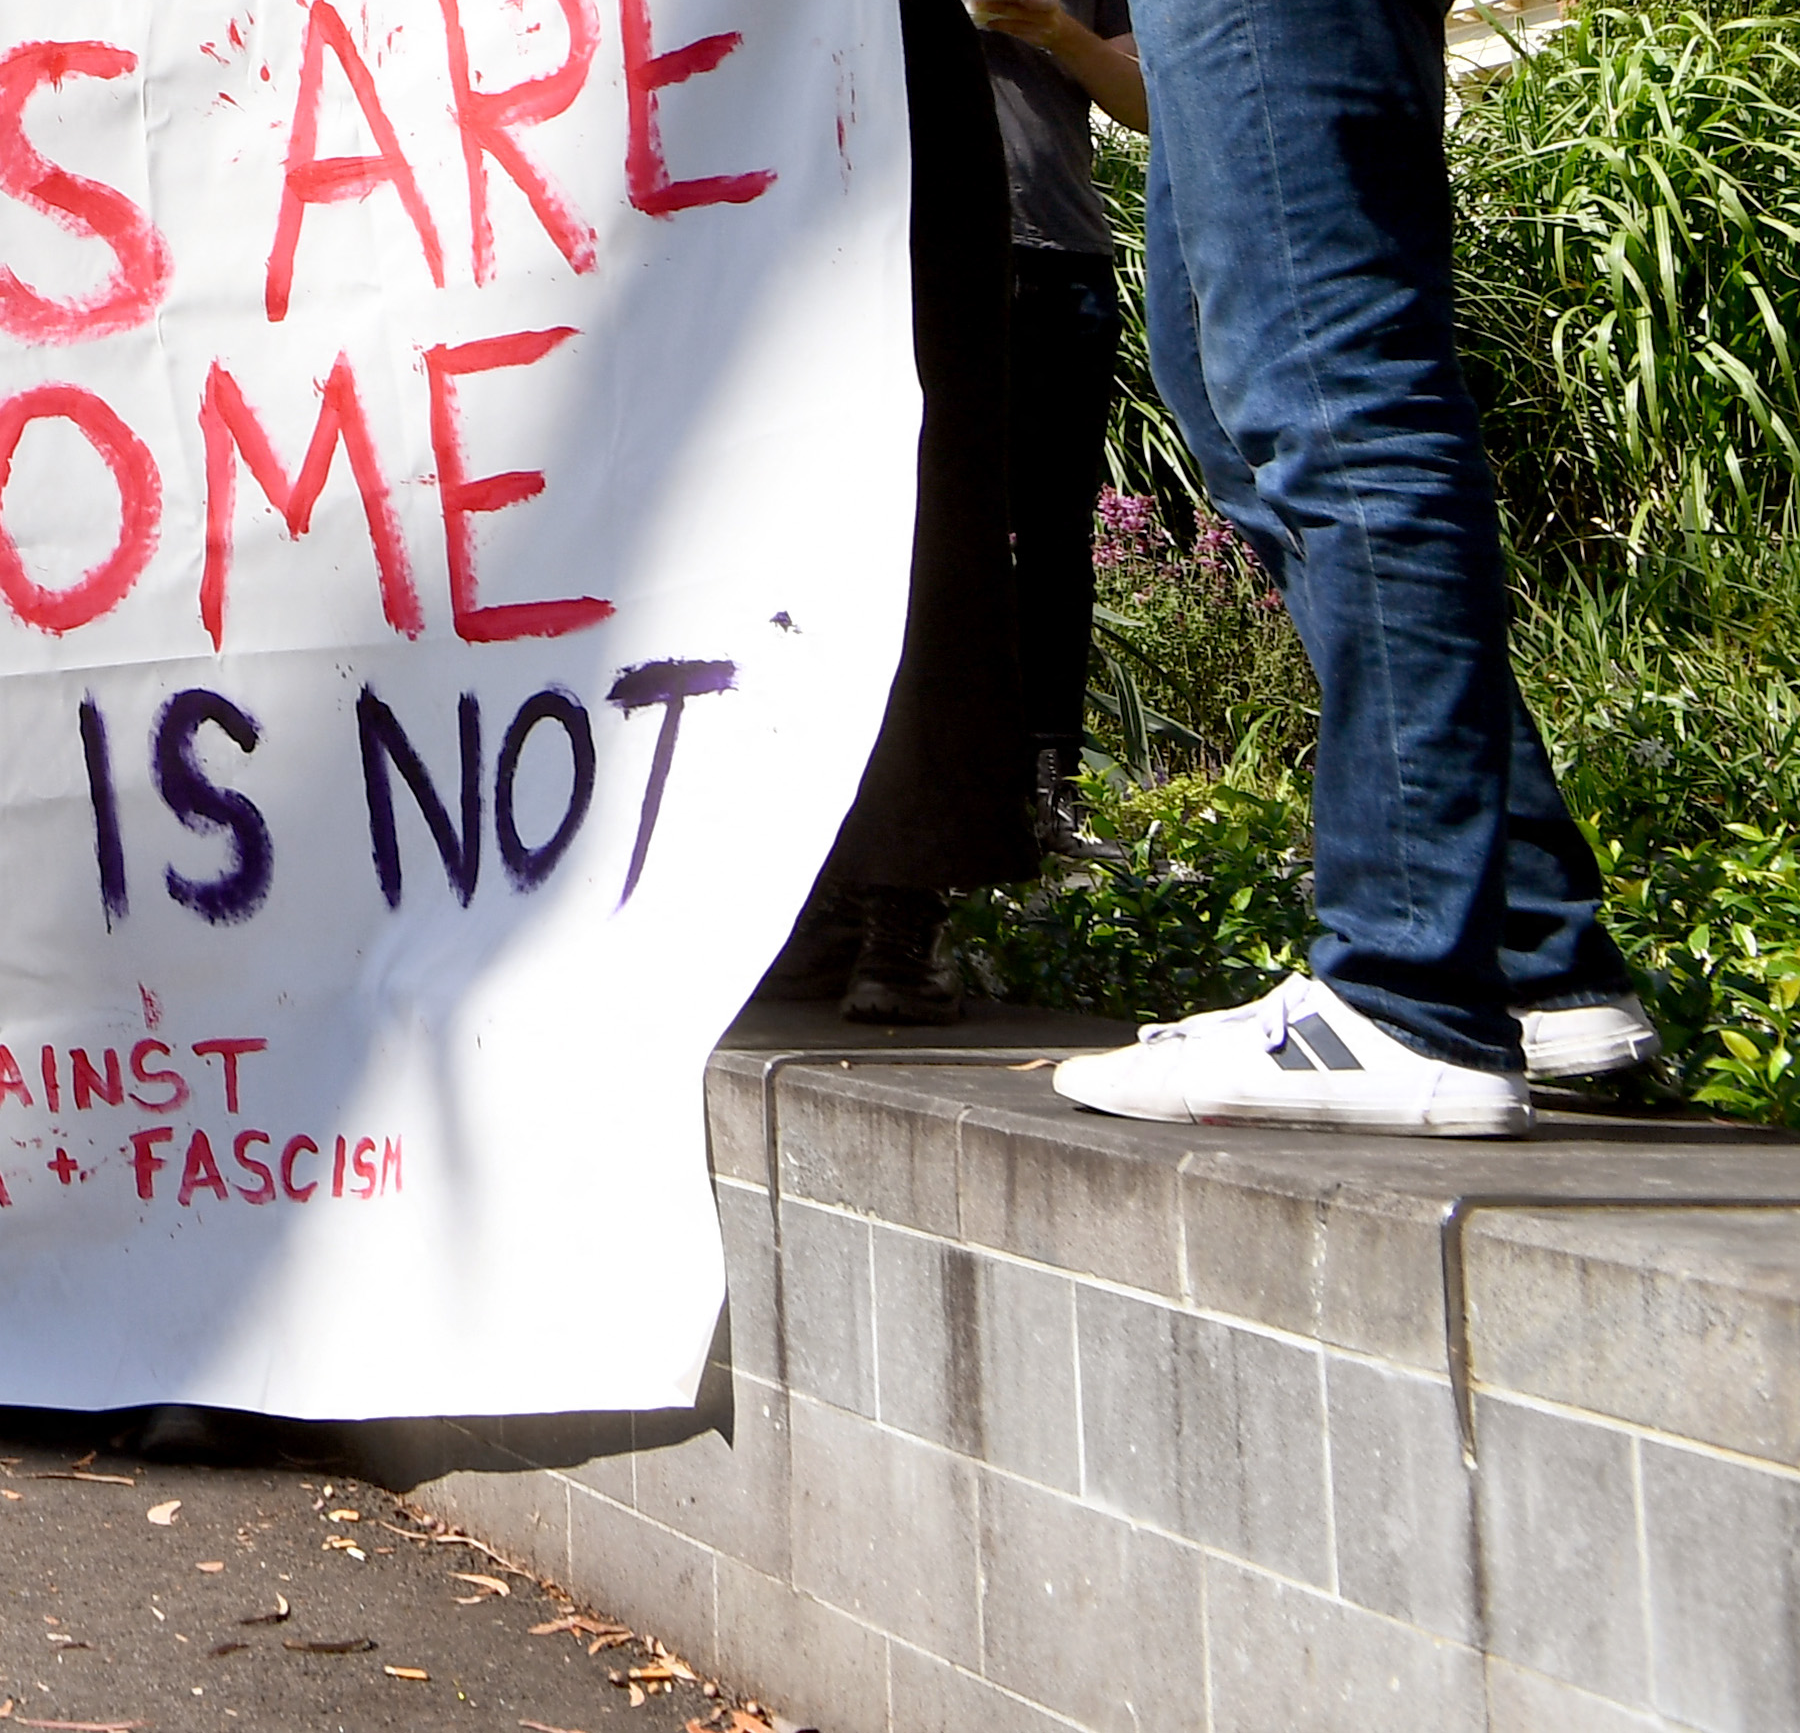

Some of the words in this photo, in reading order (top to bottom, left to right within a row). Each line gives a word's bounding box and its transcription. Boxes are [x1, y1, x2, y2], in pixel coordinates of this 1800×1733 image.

[79, 688, 274, 930] IS
[354, 660, 738, 913] NOT
[129, 1125, 403, 1207] FASCISM
